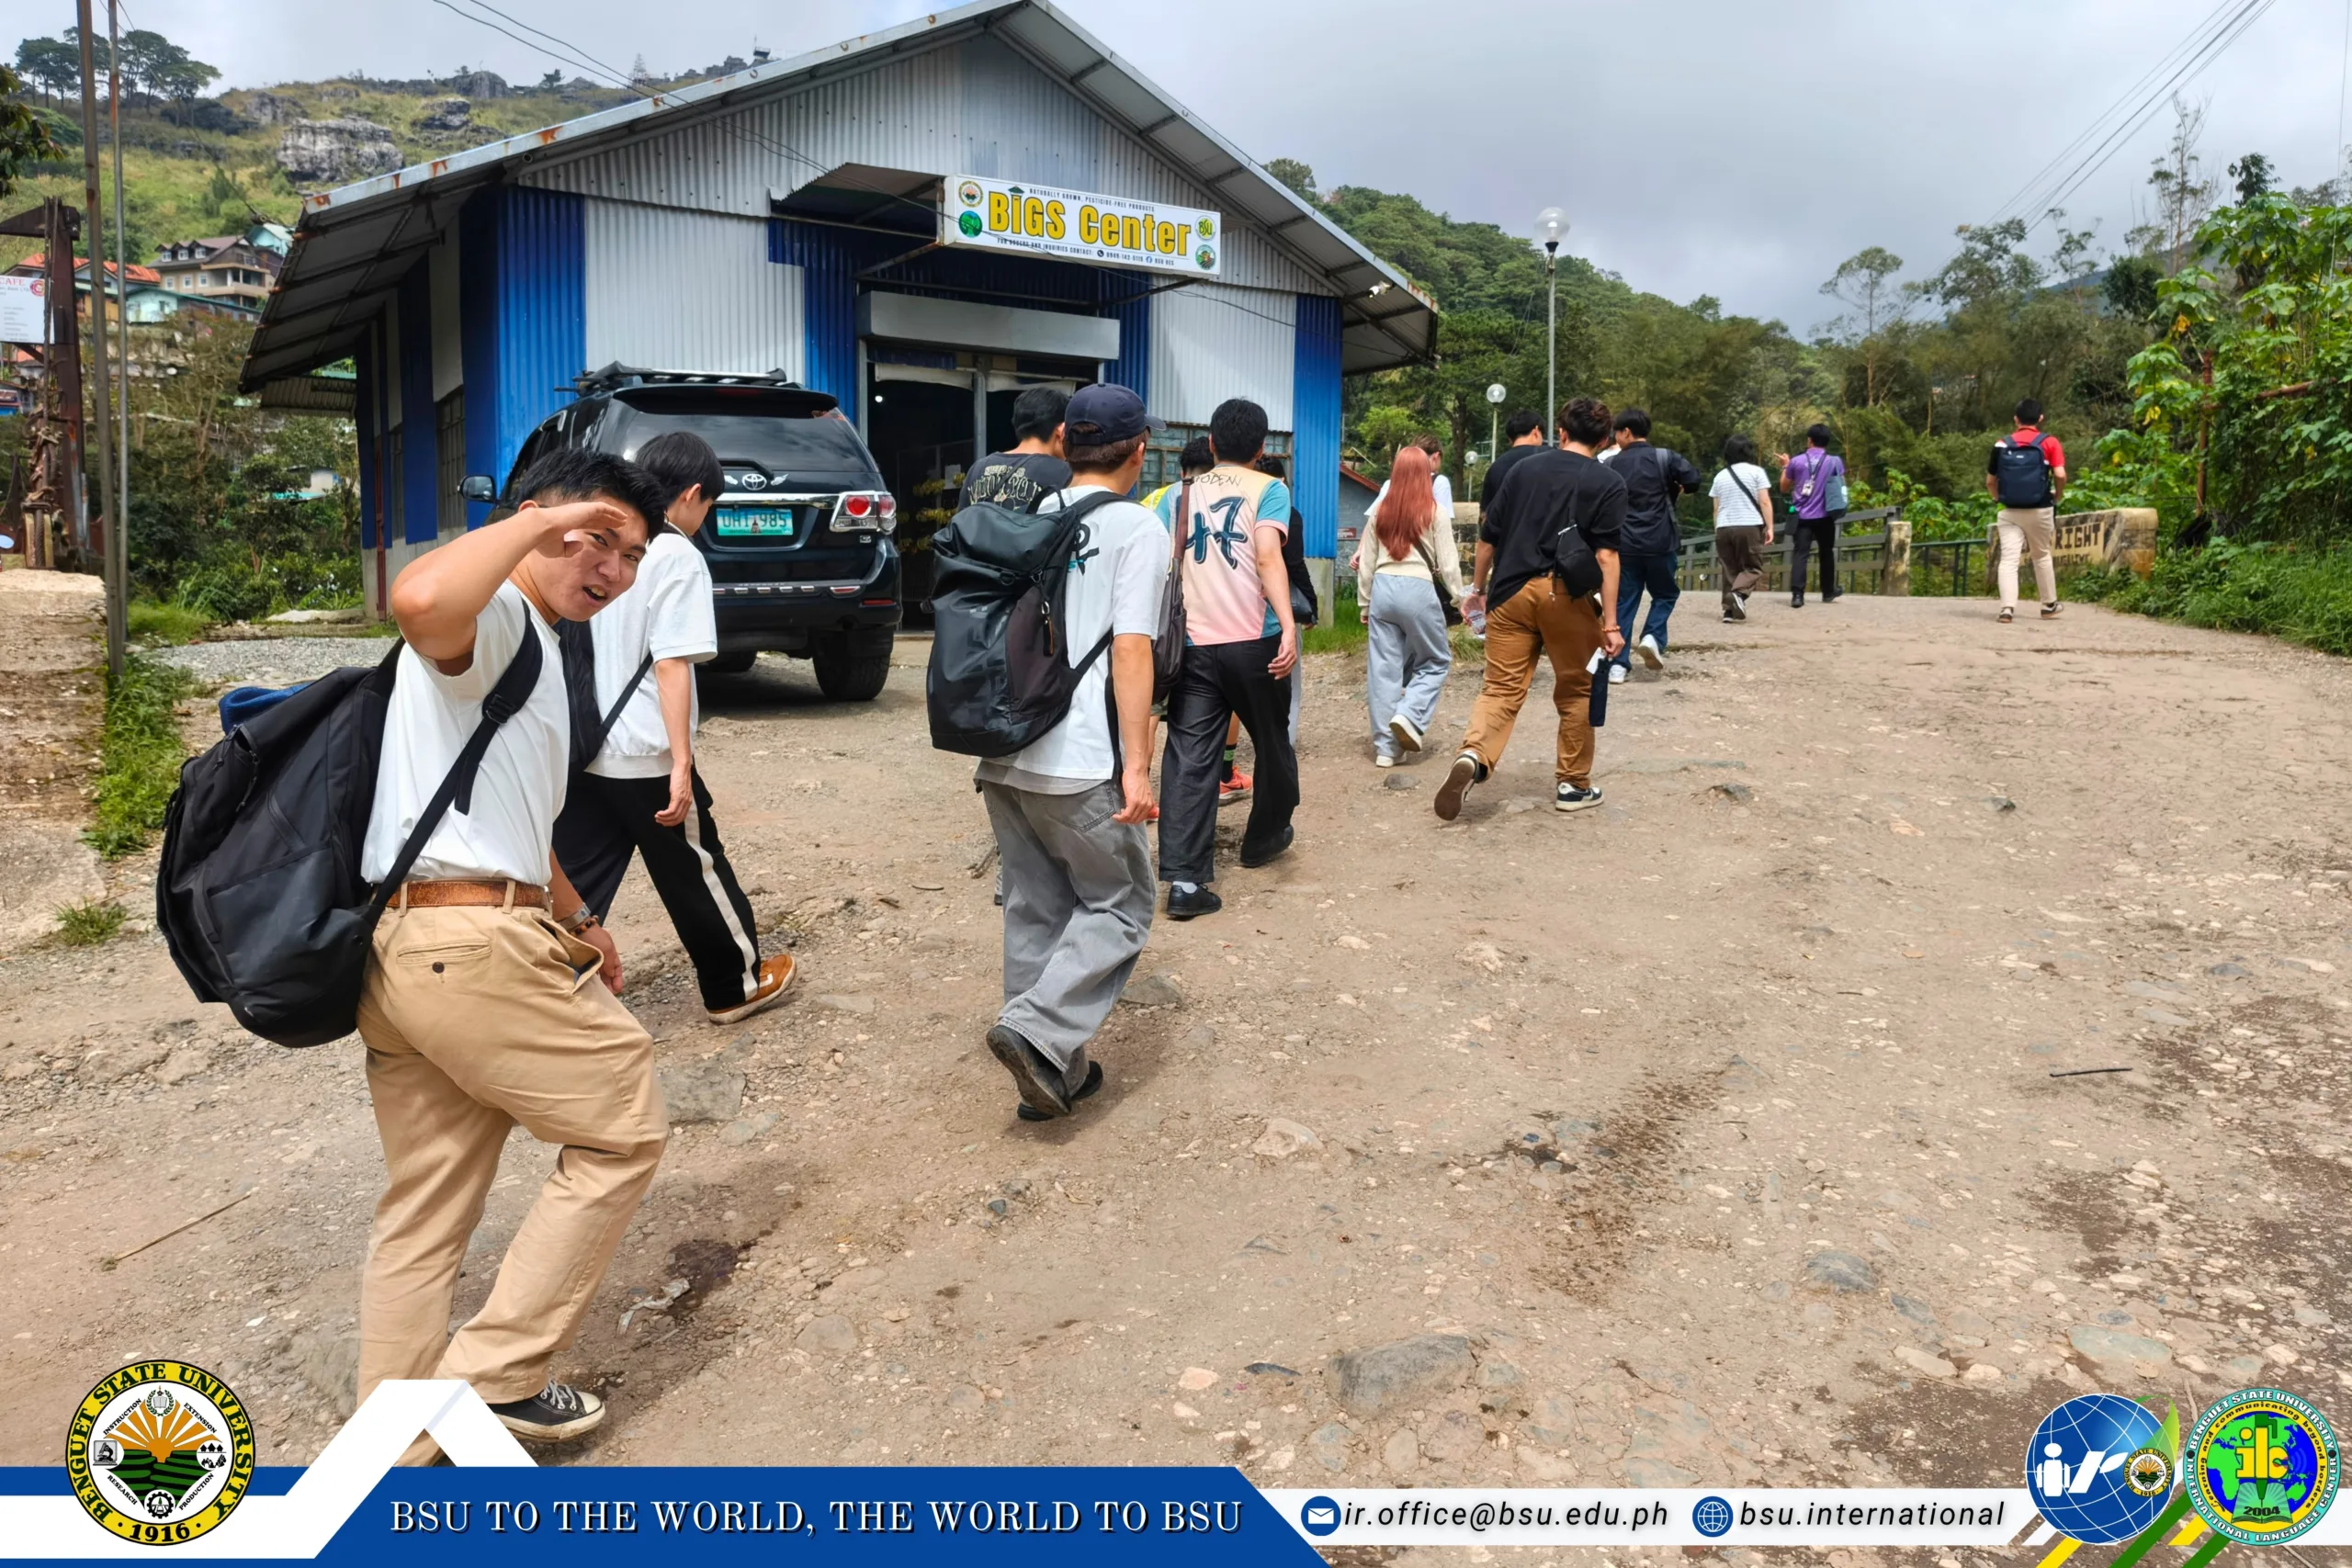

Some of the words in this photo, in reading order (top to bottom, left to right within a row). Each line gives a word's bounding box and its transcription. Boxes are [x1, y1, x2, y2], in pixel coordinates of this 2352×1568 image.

[1079, 205, 1192, 256] Center
[760, 512, 787, 528] 985
[2050, 523, 2101, 550] RIGHT
